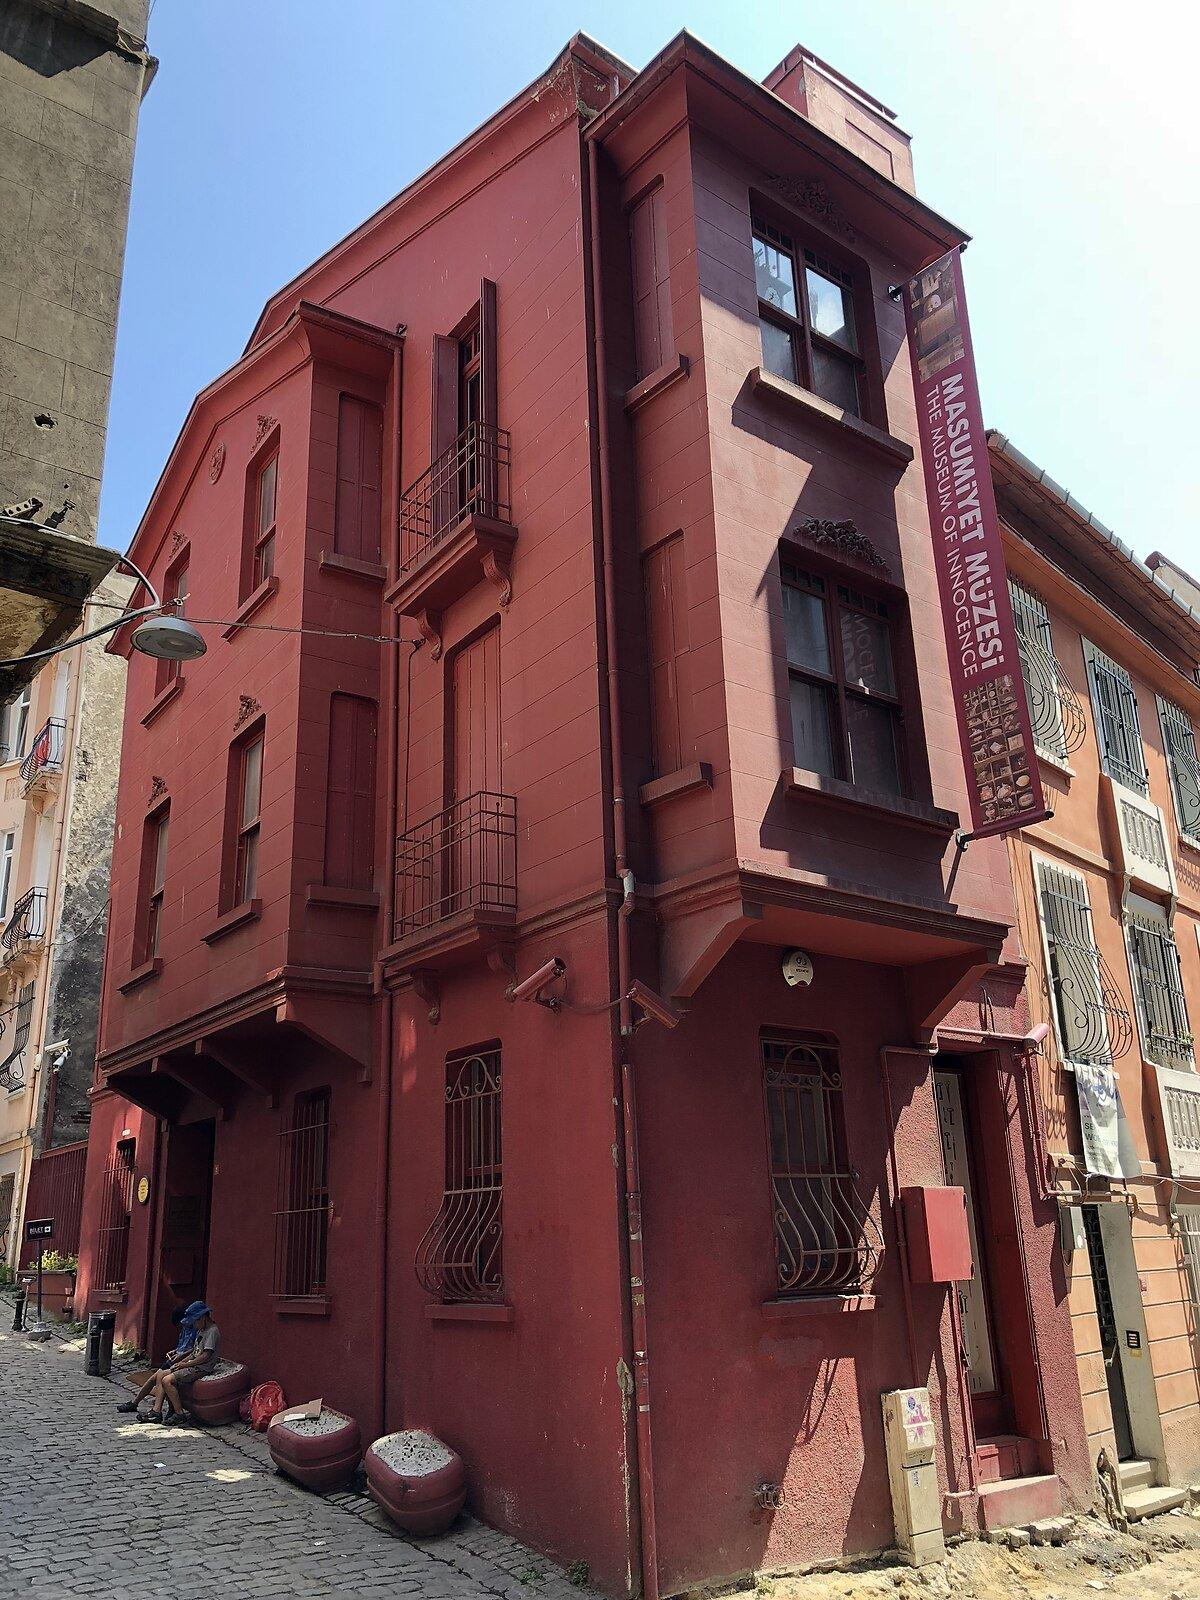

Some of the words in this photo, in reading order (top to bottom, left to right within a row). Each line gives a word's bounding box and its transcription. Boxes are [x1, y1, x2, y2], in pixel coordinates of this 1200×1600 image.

[926, 384, 942, 424] THE
[930, 425, 953, 513] MUSEUM
[941, 373, 985, 543] MASUMİYET
[964, 550, 1005, 670] MÜZESİ
[942, 515, 958, 543] OF
[946, 547, 979, 678] INNOCENCE
